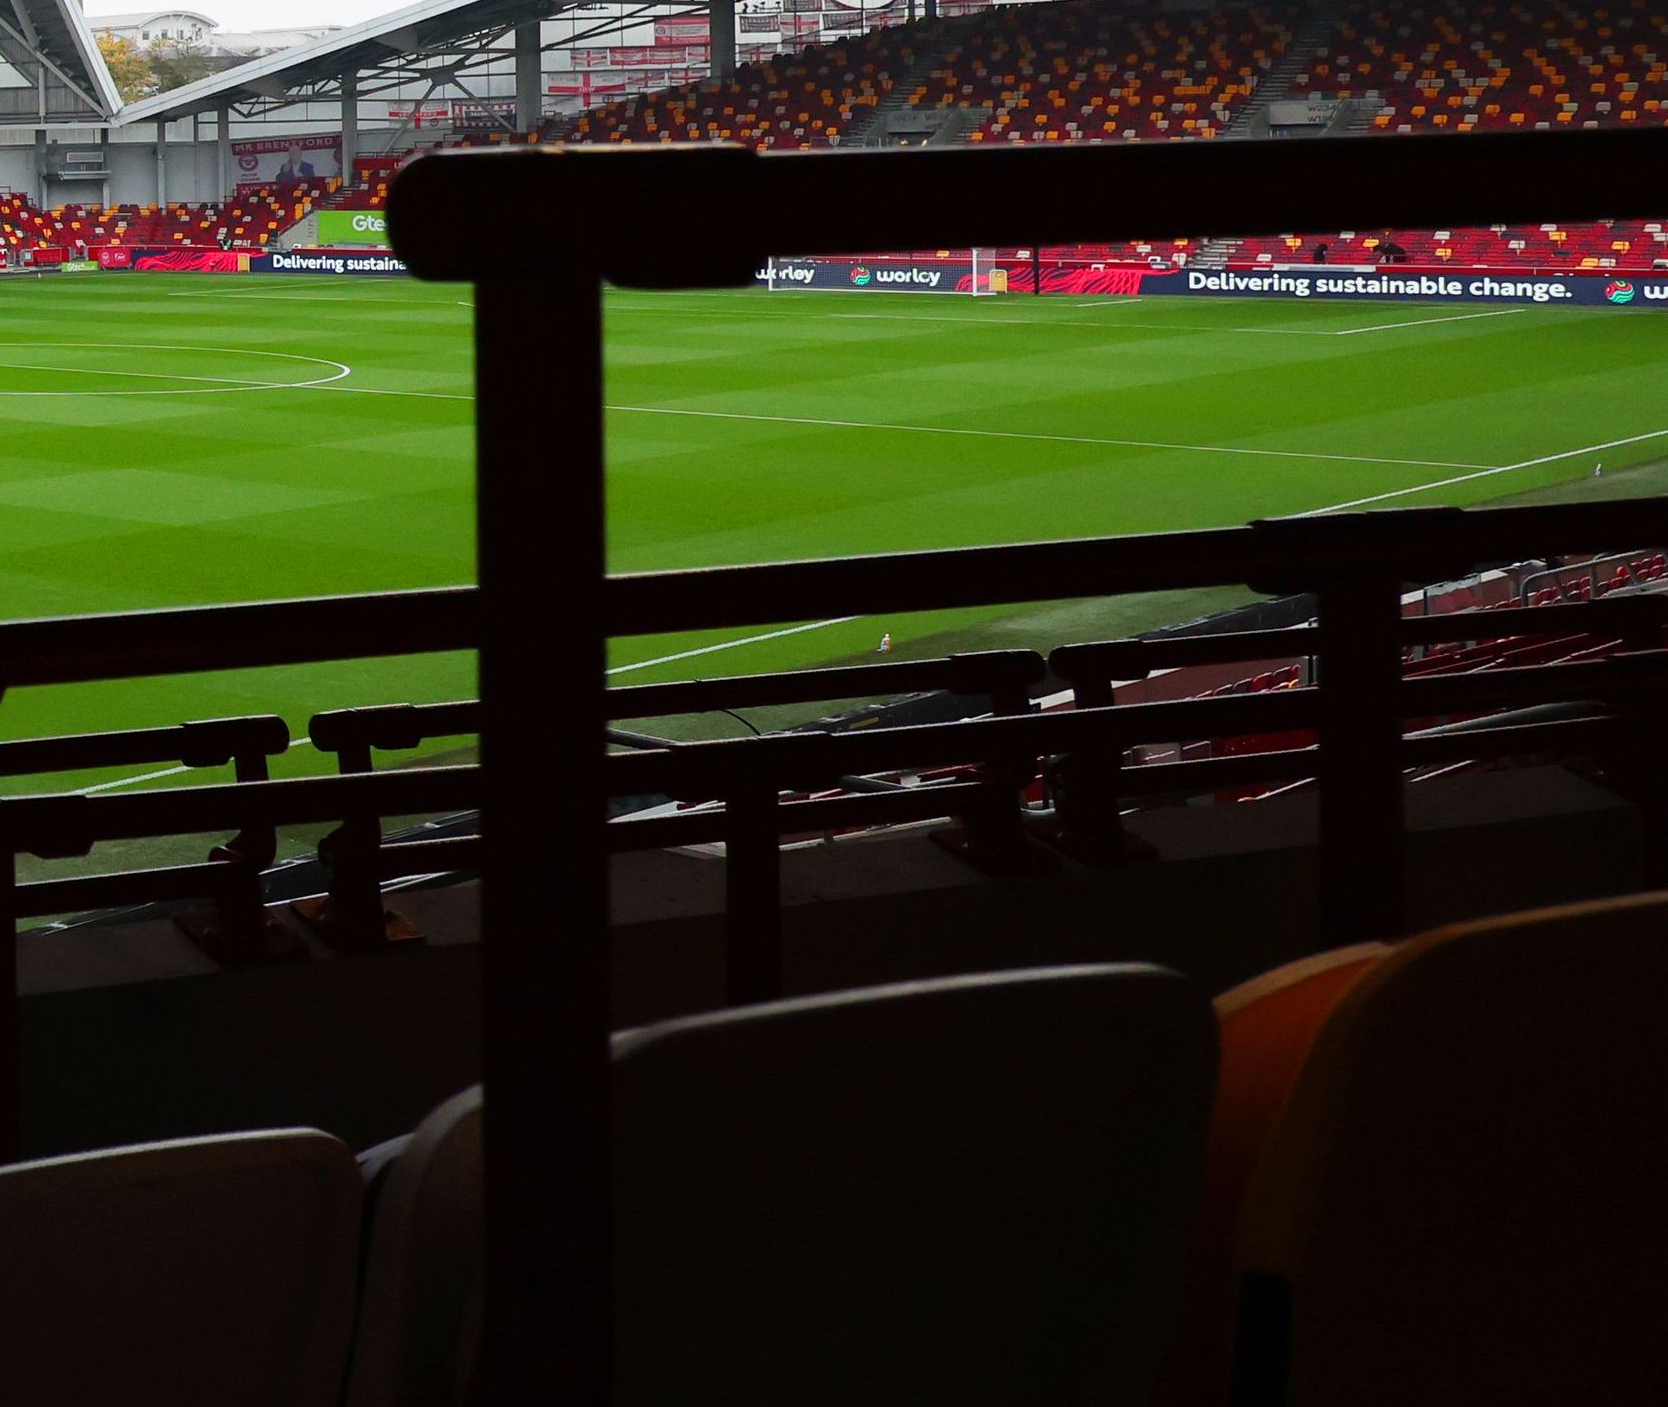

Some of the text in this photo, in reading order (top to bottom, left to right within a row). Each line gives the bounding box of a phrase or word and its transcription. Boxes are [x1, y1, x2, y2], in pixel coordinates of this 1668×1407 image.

[235, 138, 333, 152] MR BRENTFORD
[273, 254, 345, 273] Delivering
[876, 268, 941, 286] worley
[1188, 272, 1573, 302] Delivering sustainable change.
